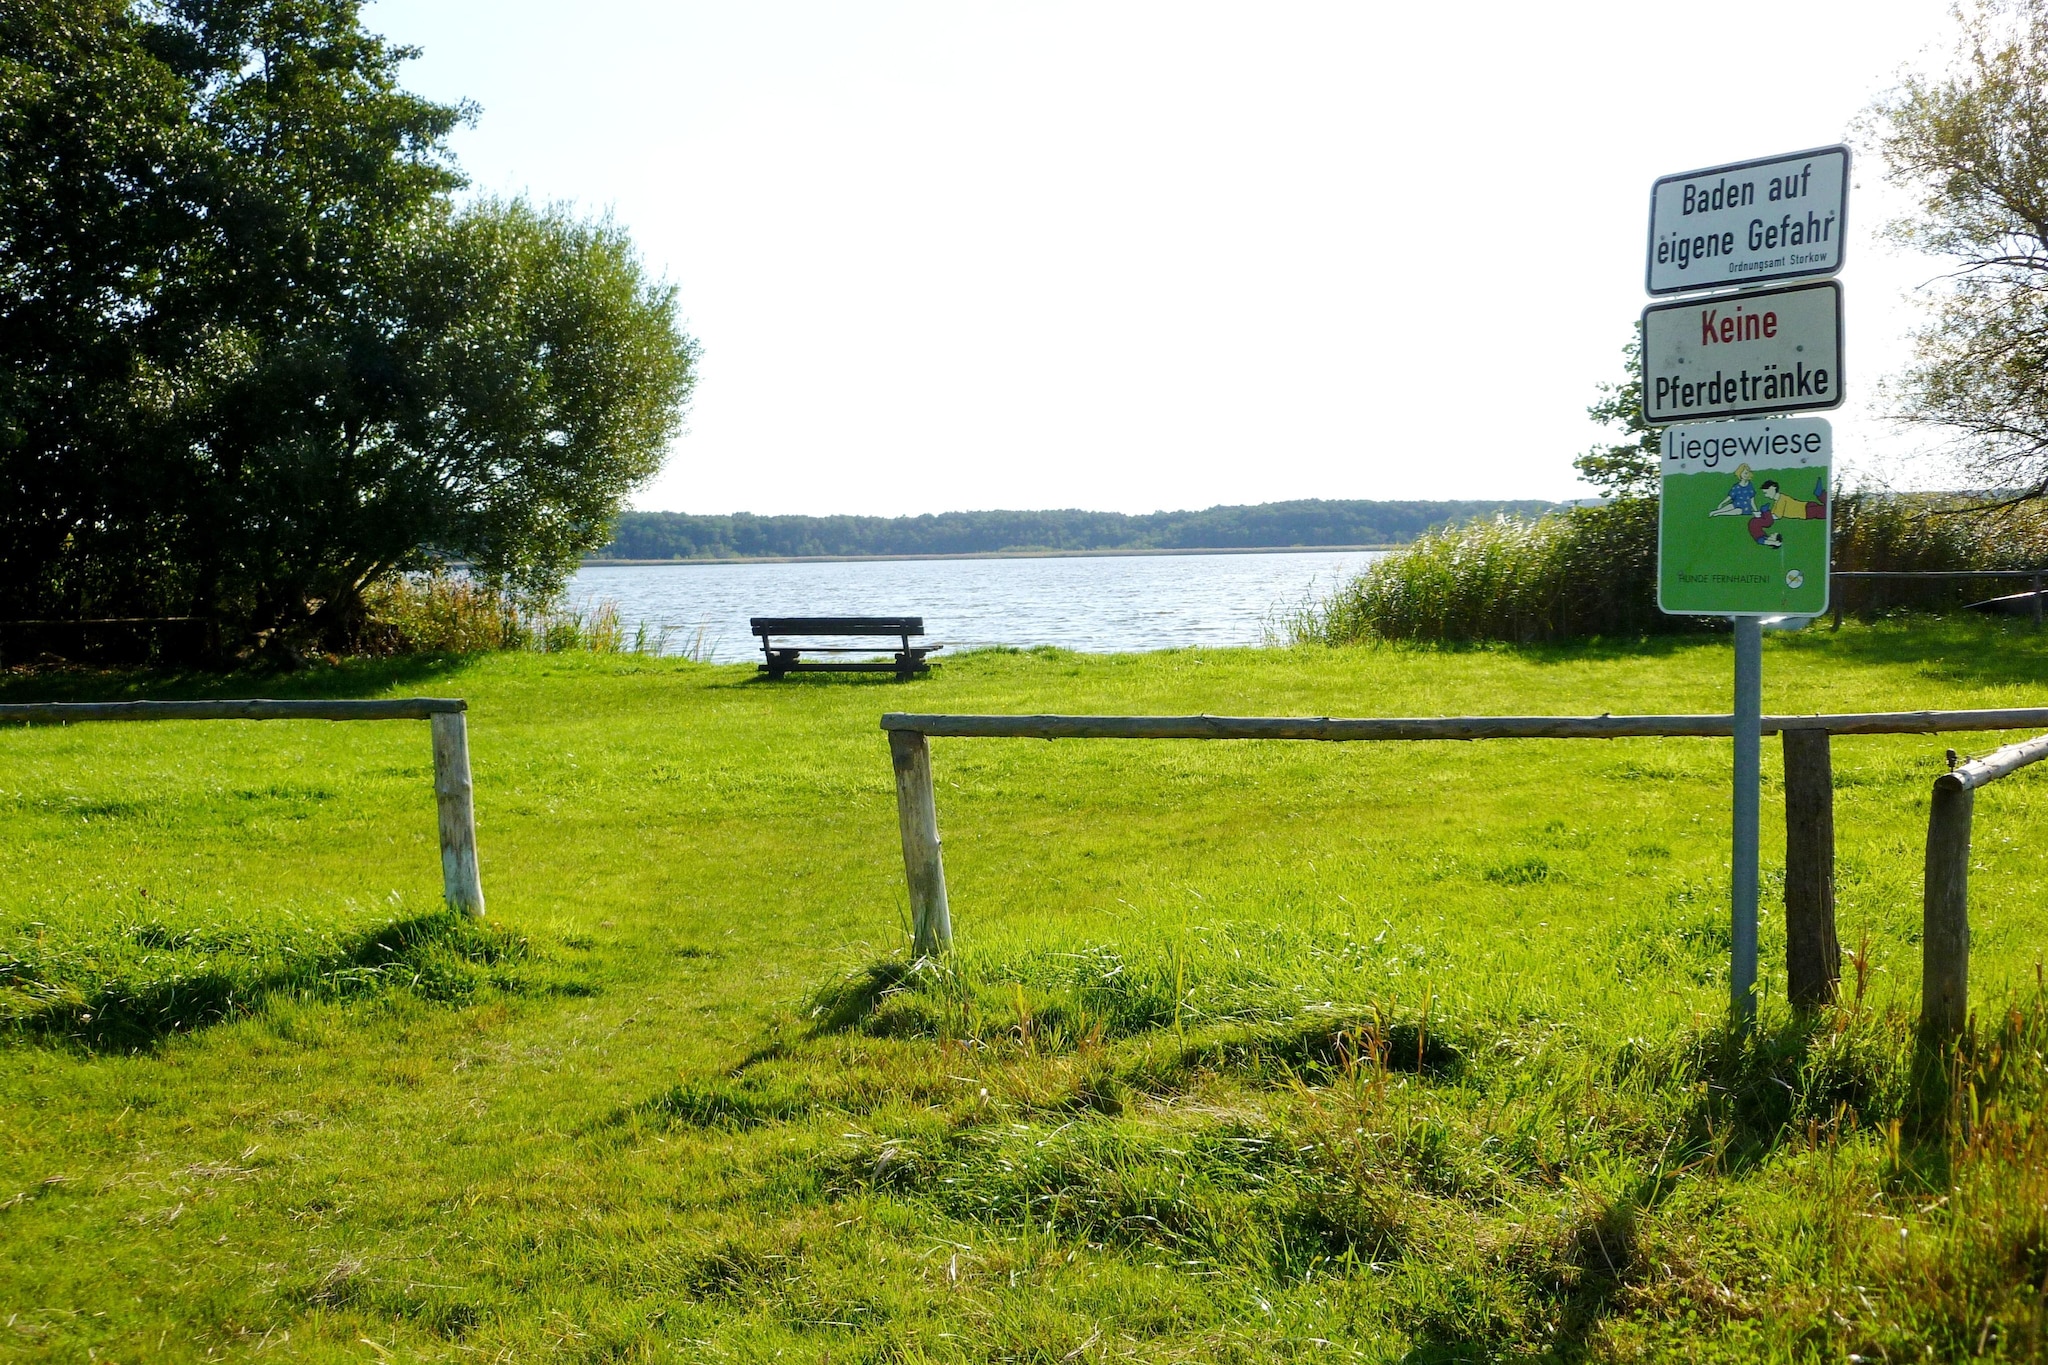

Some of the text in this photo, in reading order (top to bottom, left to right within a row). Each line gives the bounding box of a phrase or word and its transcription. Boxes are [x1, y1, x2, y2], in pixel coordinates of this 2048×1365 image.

[1682, 163, 1812, 216] Baden auf
[1657, 210, 1835, 270] eigene Gefahr
[1729, 252, 1827, 273] Ordnungsamt Storkow
[1701, 305, 1778, 346] Keine
[1656, 361, 1829, 410] Pferdetränke
[1669, 426, 1822, 467] Liegewiese
[1678, 574, 1770, 584] HUNDE FERNHALTEN!
